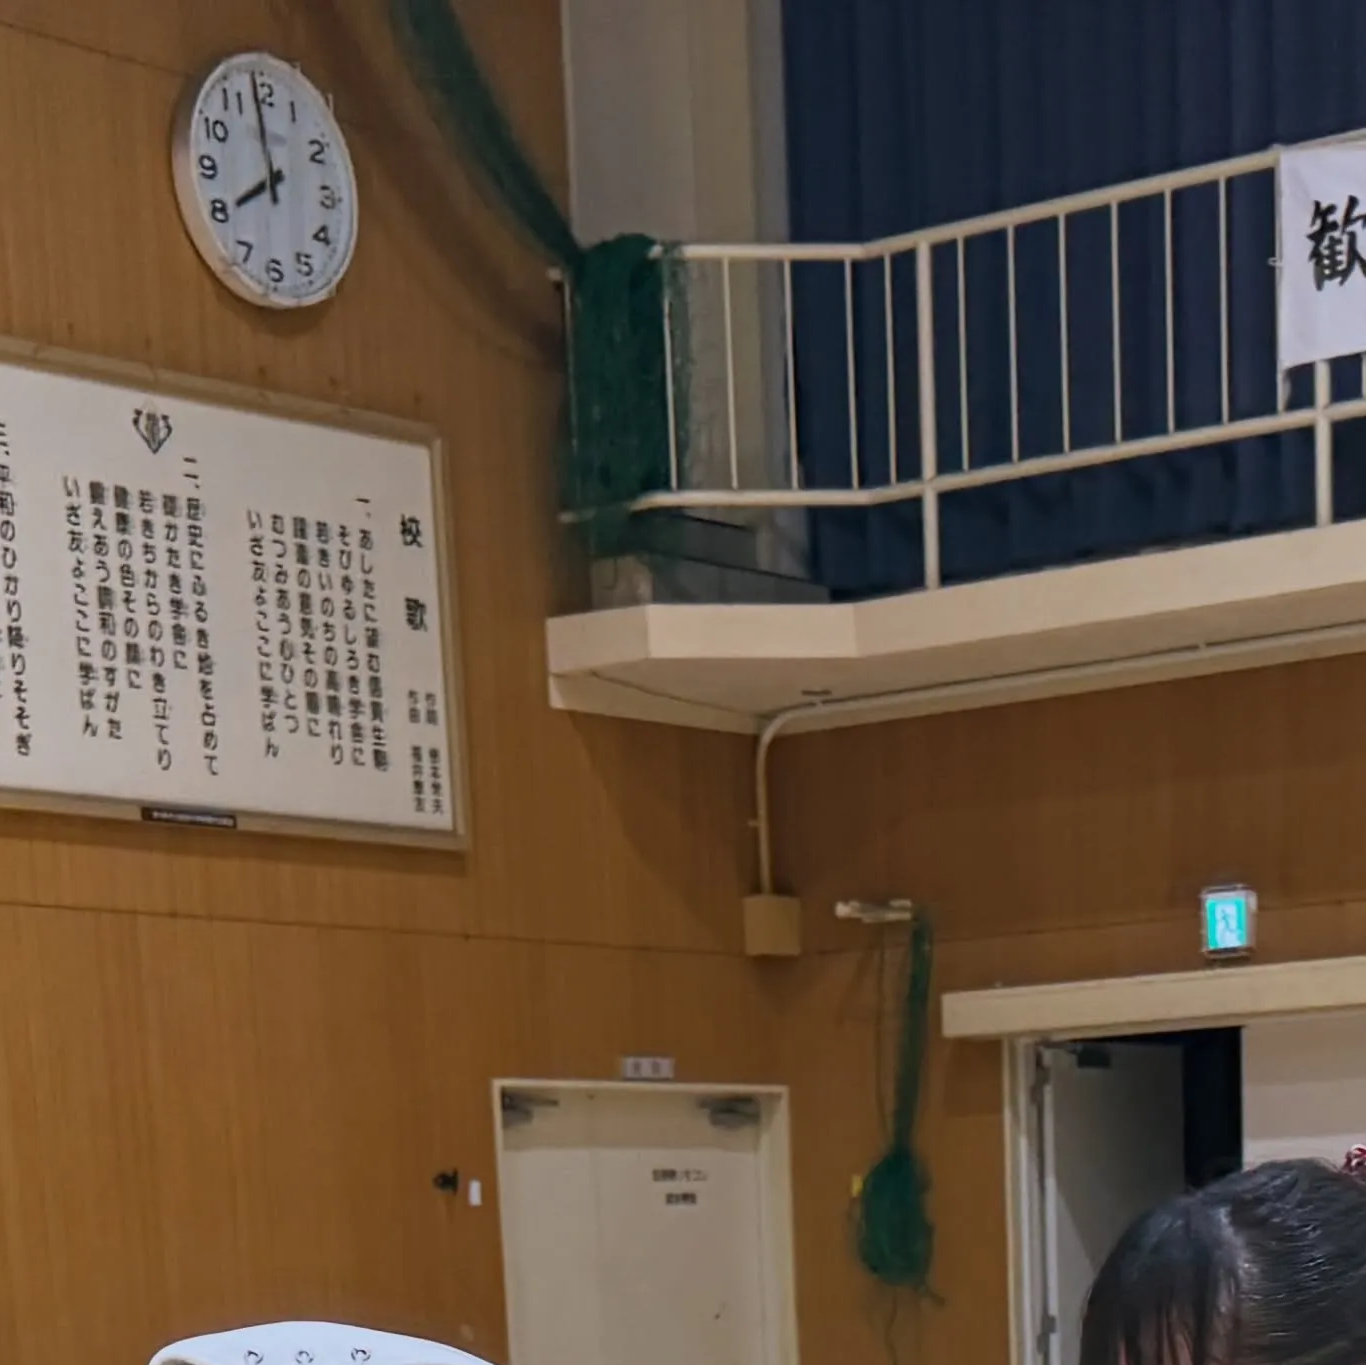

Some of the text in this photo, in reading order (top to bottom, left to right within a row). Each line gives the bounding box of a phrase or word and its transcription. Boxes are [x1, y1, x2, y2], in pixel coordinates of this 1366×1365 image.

[222, 87, 243, 116] 11
[290, 101, 296, 123] 1
[204, 116, 228, 143] 10
[309, 139, 325, 164] 2
[199, 155, 218, 179] 9
[321, 185, 336, 209] 3
[211, 200, 229, 223] 8
[313, 225, 331, 246] 4
[236, 240, 254, 263] 7
[265, 258, 284, 283] 6
[296, 252, 313, 277] 5
